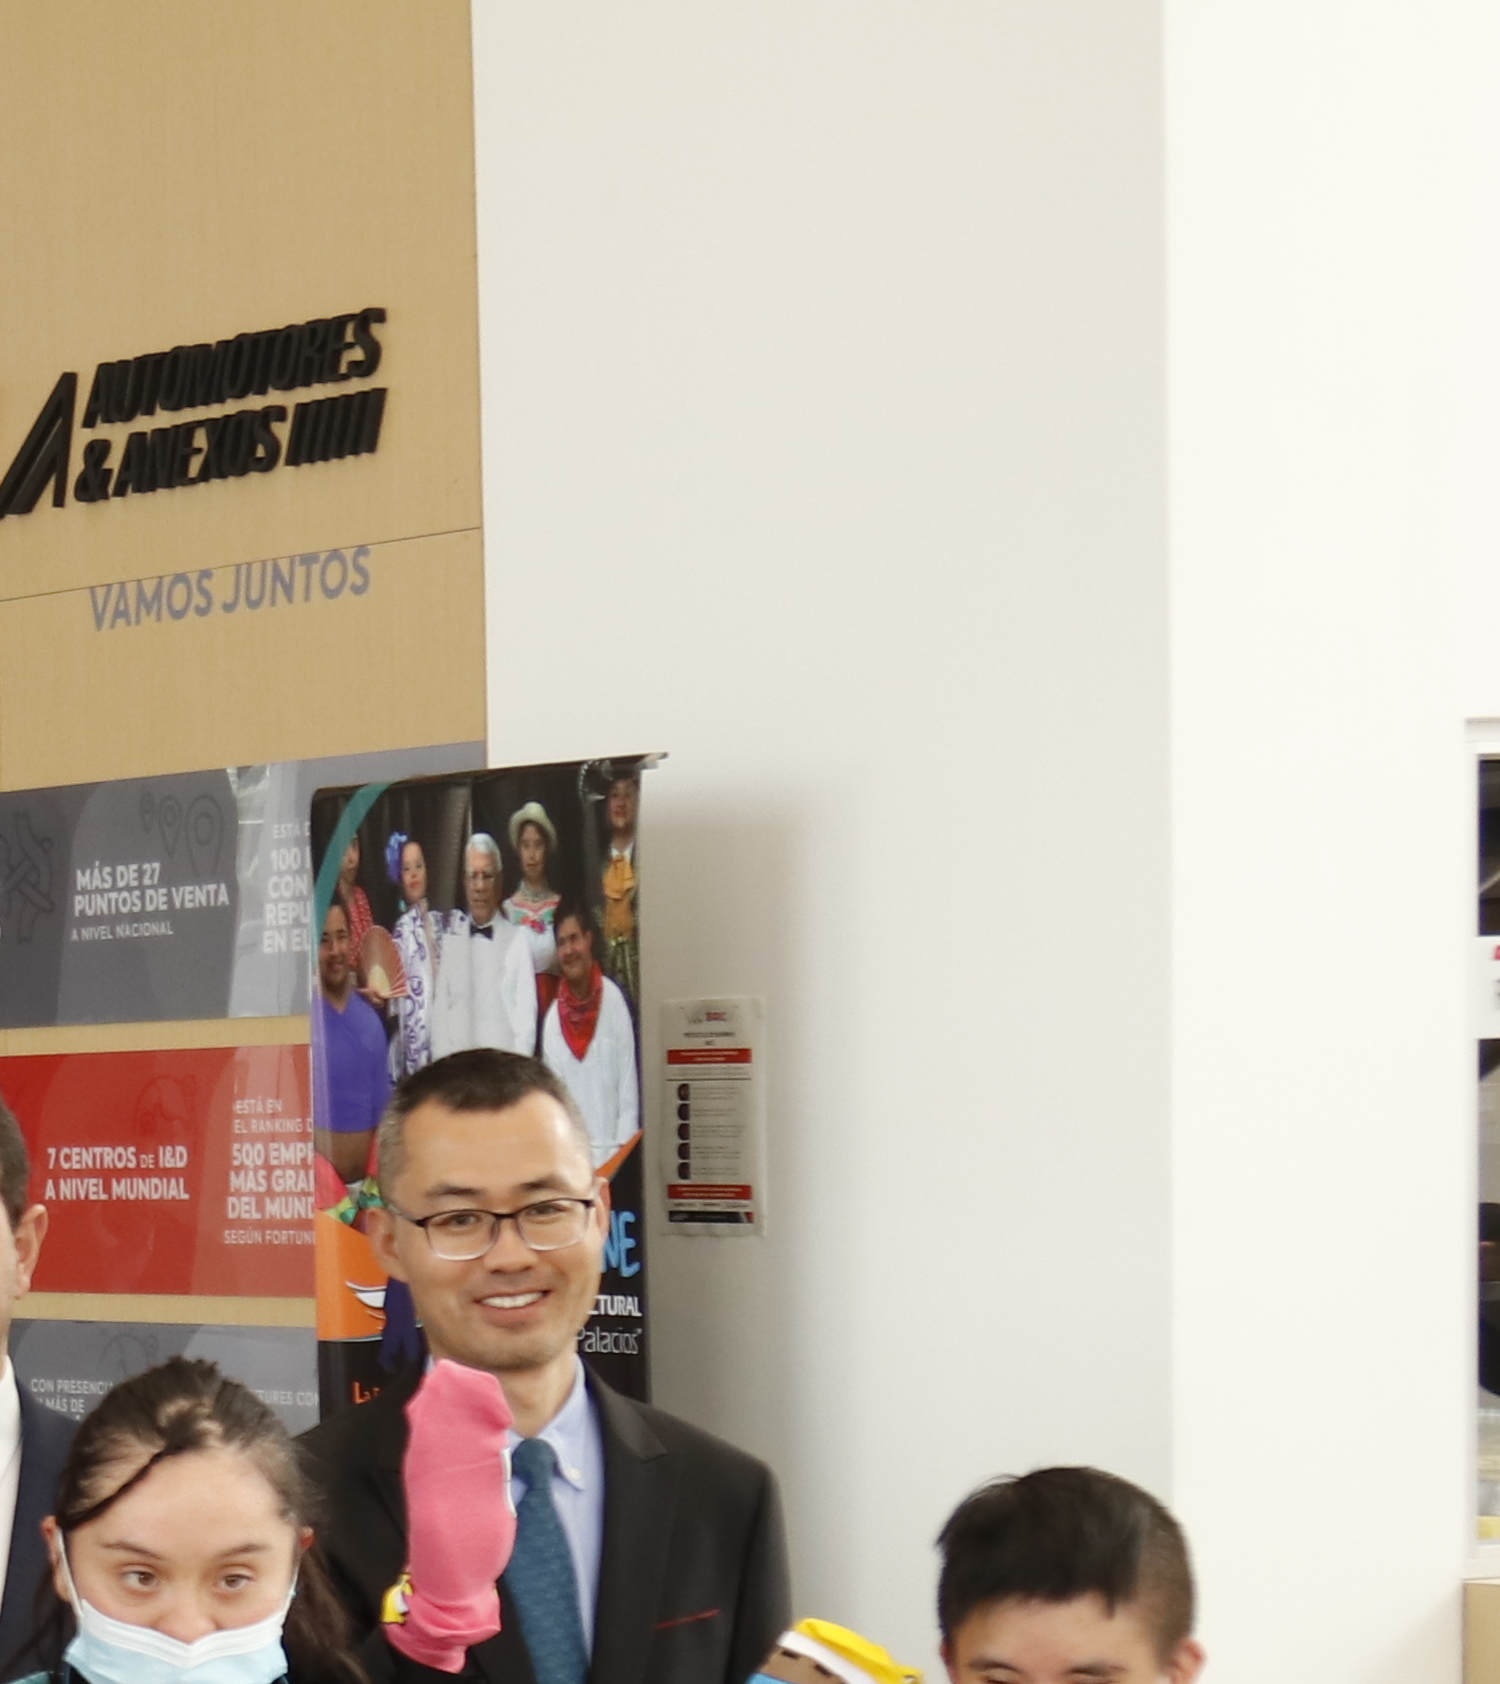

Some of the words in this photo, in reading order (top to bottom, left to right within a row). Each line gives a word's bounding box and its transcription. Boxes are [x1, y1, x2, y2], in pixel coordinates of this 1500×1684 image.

[81, 307, 387, 428] AUTOMOTORES
[73, 439, 114, 503] &
[112, 406, 288, 499] ANEXOS
[89, 567, 214, 631] VAMOS
[221, 546, 372, 614] JUNTOS
[76, 861, 115, 891] MÁS
[117, 865, 139, 889] DE
[142, 862, 161, 886] 27
[268, 874, 309, 898] CON
[74, 892, 142, 917] PUNTOS
[145, 888, 169, 912] DE
[171, 882, 230, 909] VENTA
[265, 901, 311, 926] REPU
[71, 929, 79, 942] A
[81, 925, 113, 941] NIVEL
[116, 921, 174, 939] NACIONAL
[263, 930, 287, 953] EN
[267, 1098, 282, 1114] EN
[234, 1119, 248, 1134] EL
[251, 1118, 303, 1133] RANKING
[47, 1147, 57, 1170] 7
[59, 1146, 137, 1170] CENTROS
[140, 1154, 155, 1168] DE
[158, 1145, 188, 1168] I&D
[45, 1178, 56, 1200] A
[59, 1178, 108, 1200] NIVEL
[111, 1177, 190, 1200] MUNDIAL
[230, 1165, 268, 1193] MÁS
[227, 1196, 261, 1220] DEL
[30, 1379, 54, 1393] CON
[70, 1398, 85, 1413] DE
